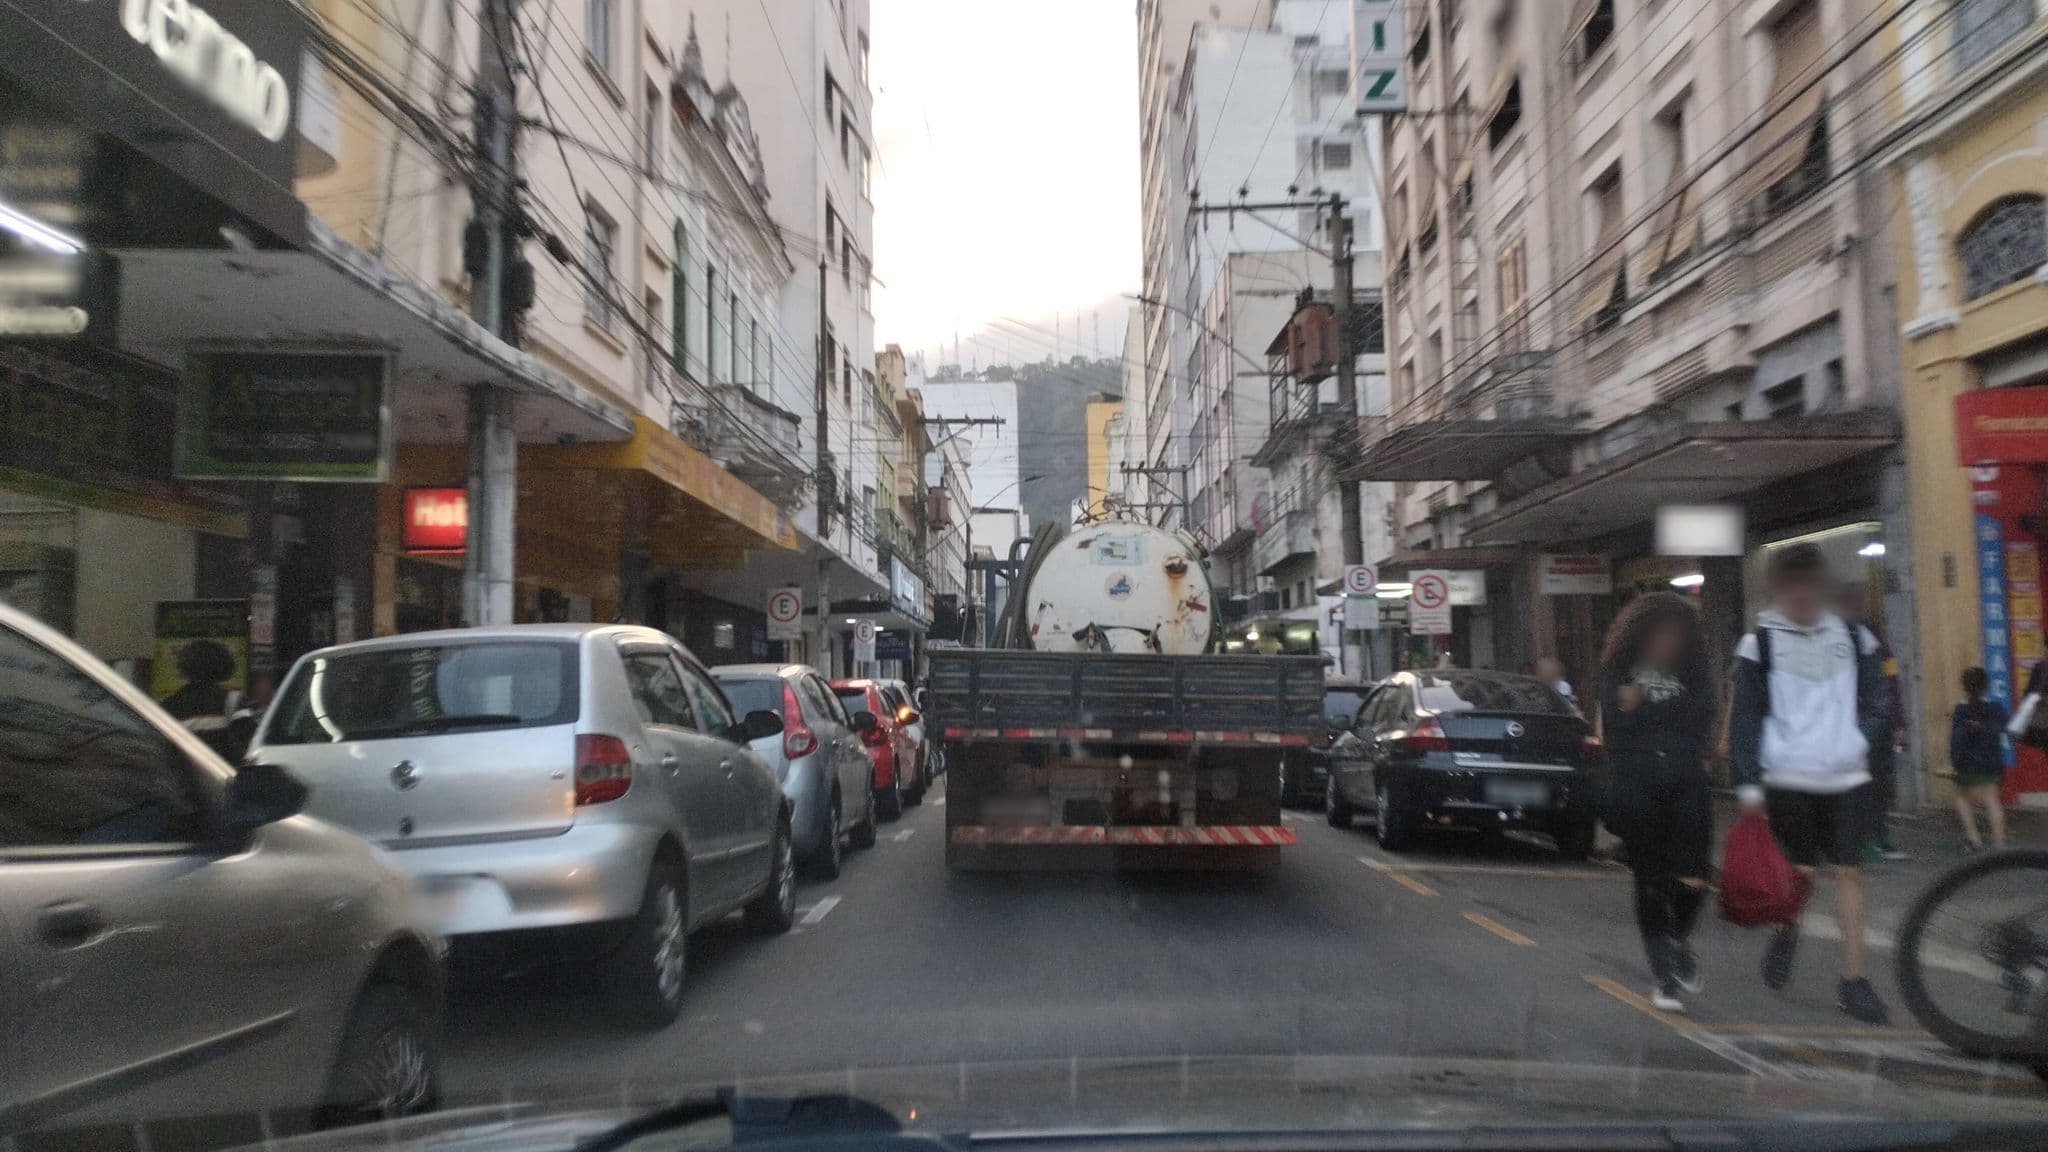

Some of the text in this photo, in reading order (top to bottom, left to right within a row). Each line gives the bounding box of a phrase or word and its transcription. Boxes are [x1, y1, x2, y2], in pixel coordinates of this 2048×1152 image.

[1363, 0, 1398, 101] IZ
[1356, 571, 1366, 587] E
[779, 598, 789, 614] E
